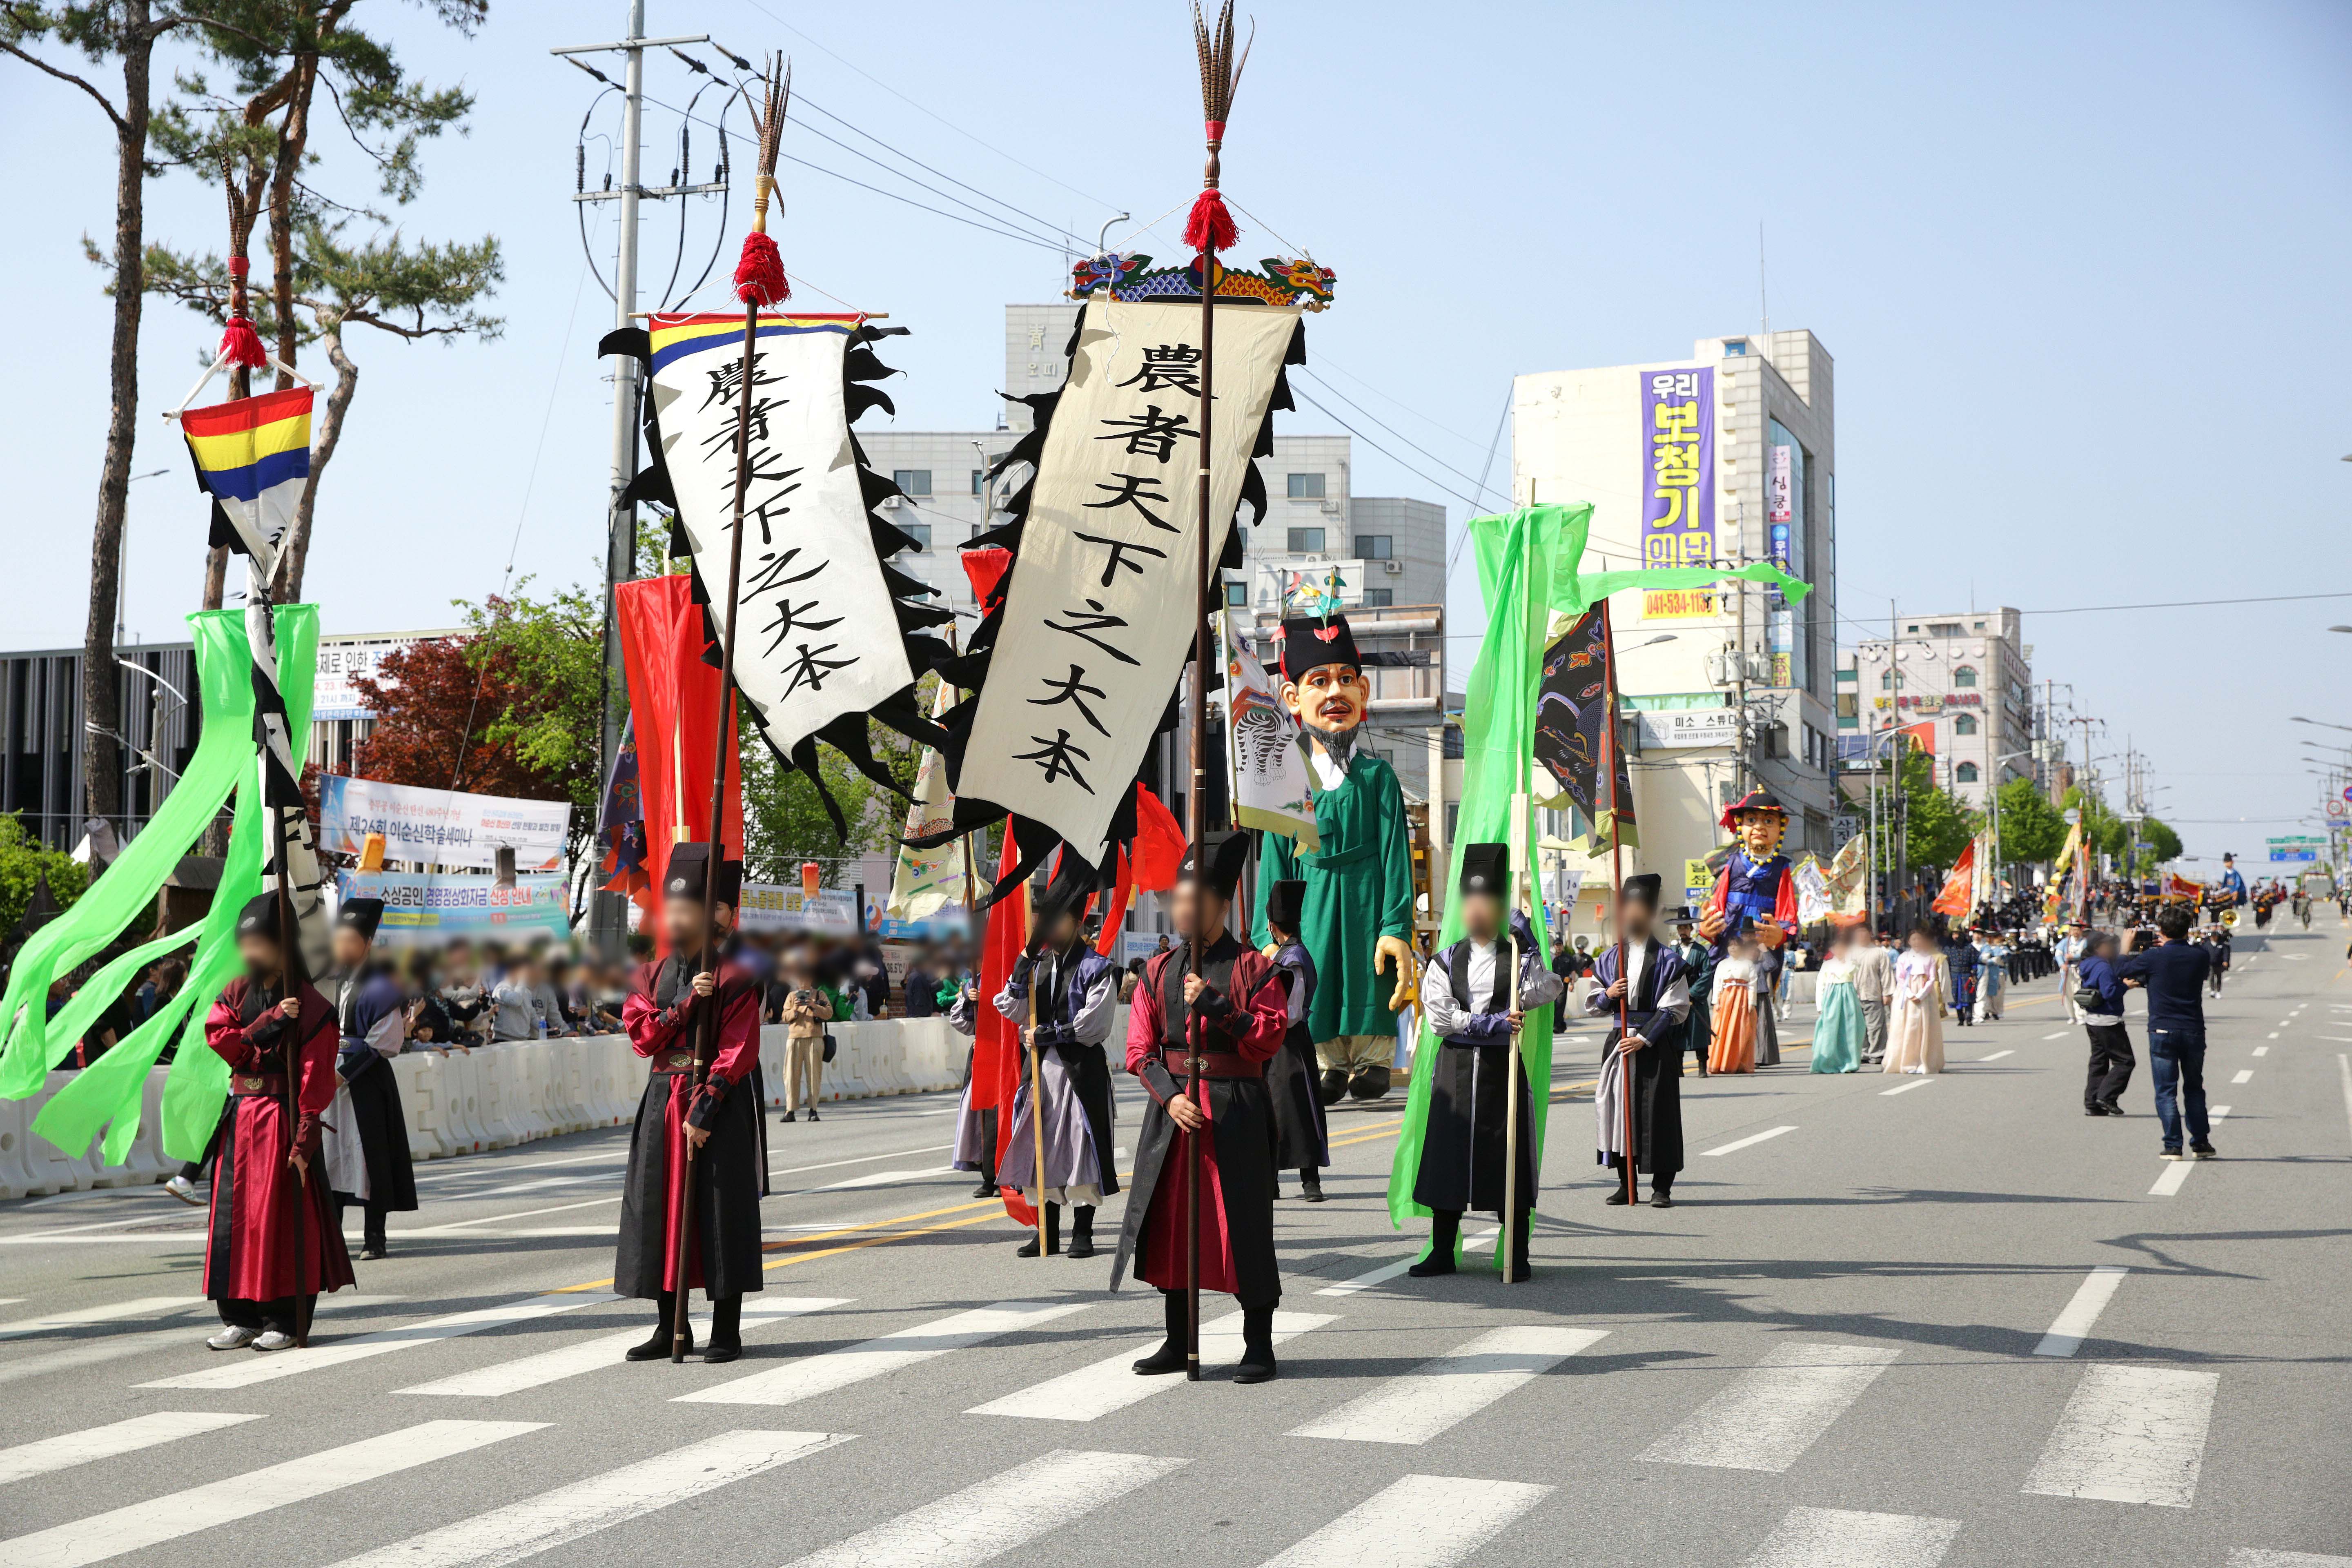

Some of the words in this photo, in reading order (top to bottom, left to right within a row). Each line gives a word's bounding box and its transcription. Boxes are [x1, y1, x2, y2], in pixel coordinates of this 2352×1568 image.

[1028, 363, 1069, 376] 오피
[1652, 373, 1698, 399] 우리
[1652, 401, 1700, 529] 보청기
[1011, 343, 1218, 795] 農者天下之大本
[316, 653, 341, 674] 제로
[345, 652, 367, 672] 인한
[1675, 717, 1695, 727] 미소
[389, 801, 409, 815] 이순신
[390, 820, 472, 848] 이순신학술세미나
[381, 886, 423, 906] 소상공인
[426, 887, 487, 906] 경영정상화자금
[512, 886, 532, 906] 안내
[786, 892, 802, 911] 상담
